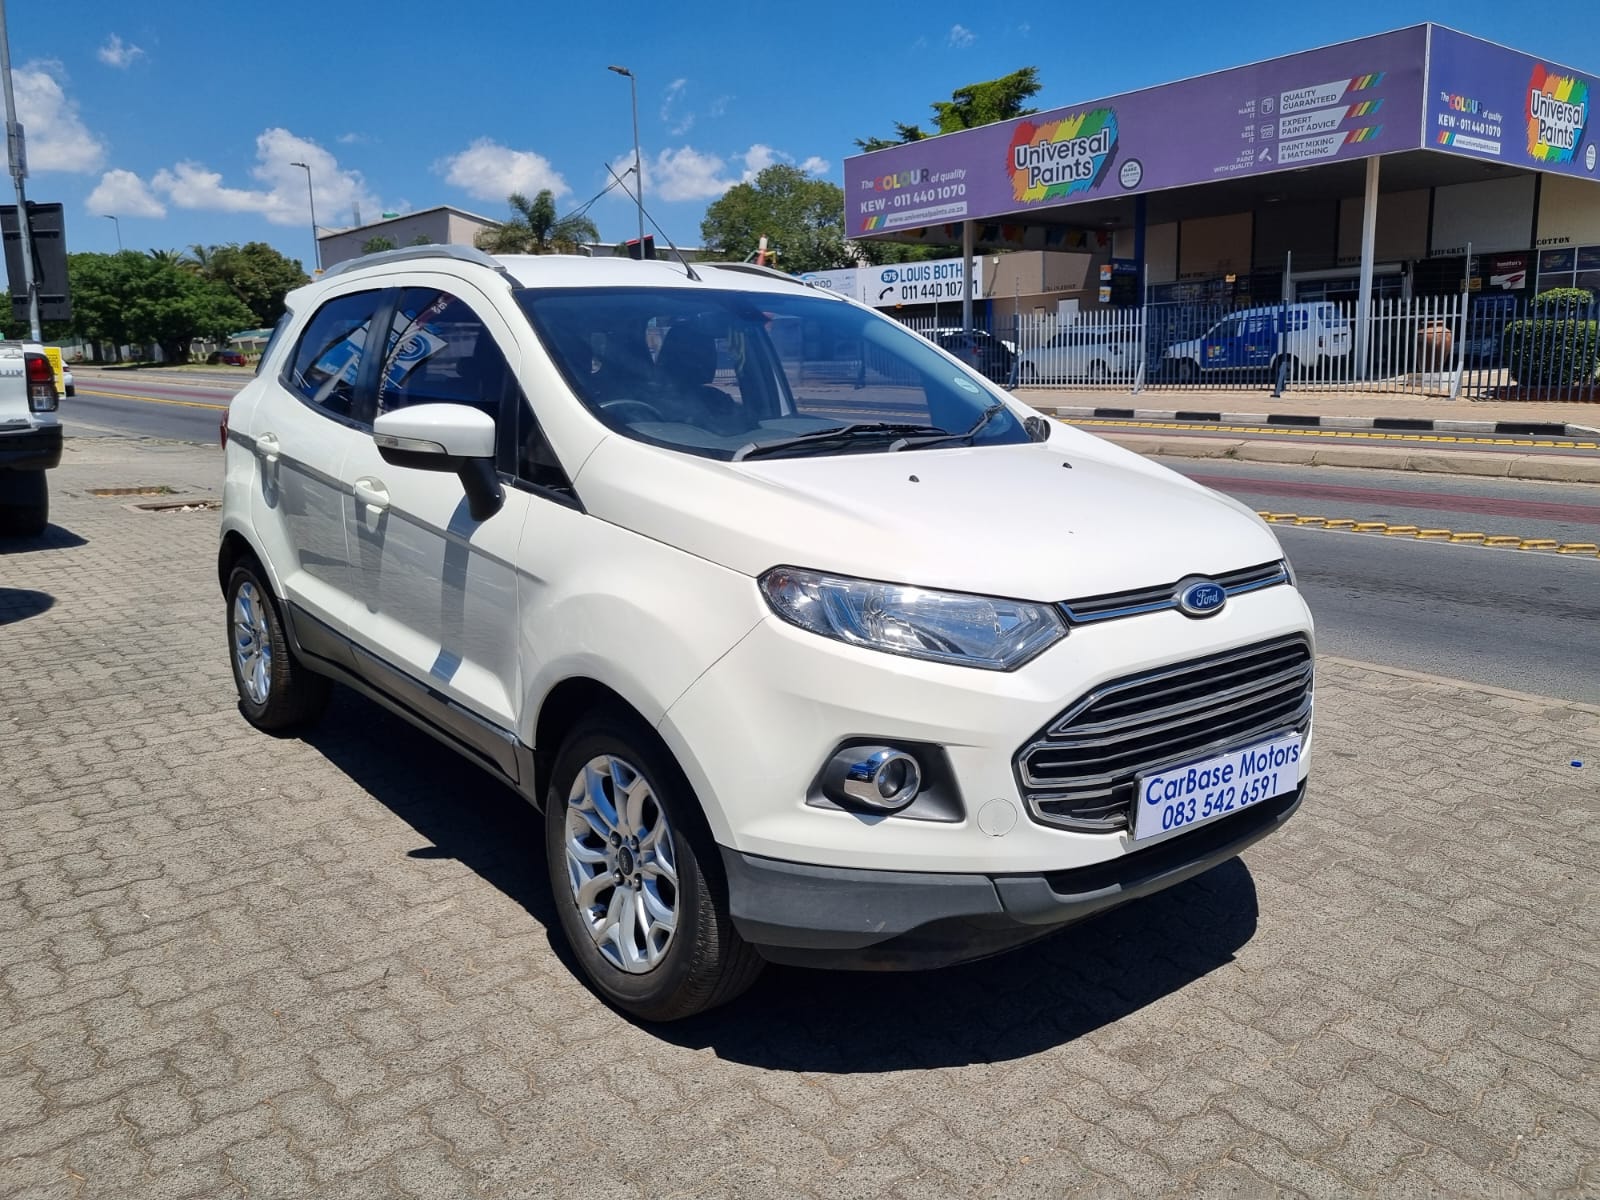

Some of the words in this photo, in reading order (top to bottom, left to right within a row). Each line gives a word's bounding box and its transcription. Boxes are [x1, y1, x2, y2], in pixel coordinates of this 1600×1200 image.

[1282, 94, 1337, 110] GUARANTEED
[1283, 89, 1316, 102] QUALITY
[1440, 91, 1449, 102] The
[1449, 94, 1483, 114] COLOUR
[1483, 110, 1489, 118] of
[1531, 91, 1584, 128] Universal
[1281, 125, 1304, 135] PAINT
[1306, 119, 1336, 130] ADVICE
[1282, 115, 1312, 127] EXPERT
[1438, 113, 1456, 127] KEW
[1460, 118, 1471, 131] 011
[1471, 121, 1485, 134] 440
[1485, 124, 1501, 137] 1070
[1281, 142, 1304, 152] PAINT
[1305, 137, 1334, 148] MIXING
[1538, 119, 1574, 148] Paints
[1015, 128, 1109, 167] Universal
[1287, 146, 1329, 159] MATCHING
[861, 180, 874, 190] The
[874, 168, 930, 192] COLOUR
[930, 172, 940, 183] of
[940, 169, 966, 183] quality
[1030, 158, 1092, 187] Paints
[860, 198, 886, 213] KEW
[894, 194, 911, 207] 011
[913, 189, 935, 204] 440
[937, 183, 966, 199] 1070
[1536, 236, 1571, 246] COTTON
[883, 272, 897, 282] 575
[900, 265, 931, 283] LOUIS
[934, 262, 964, 280] BOTH
[901, 284, 918, 300] 011
[920, 283, 942, 299] 440
[945, 280, 978, 296] 1071
[1196, 588, 1219, 607] Ford
[1145, 763, 1234, 806] CarBase
[1238, 743, 1300, 779] Motors
[1161, 797, 1197, 831] 083
[1201, 786, 1236, 818] 542
[1240, 772, 1279, 807] 6591
